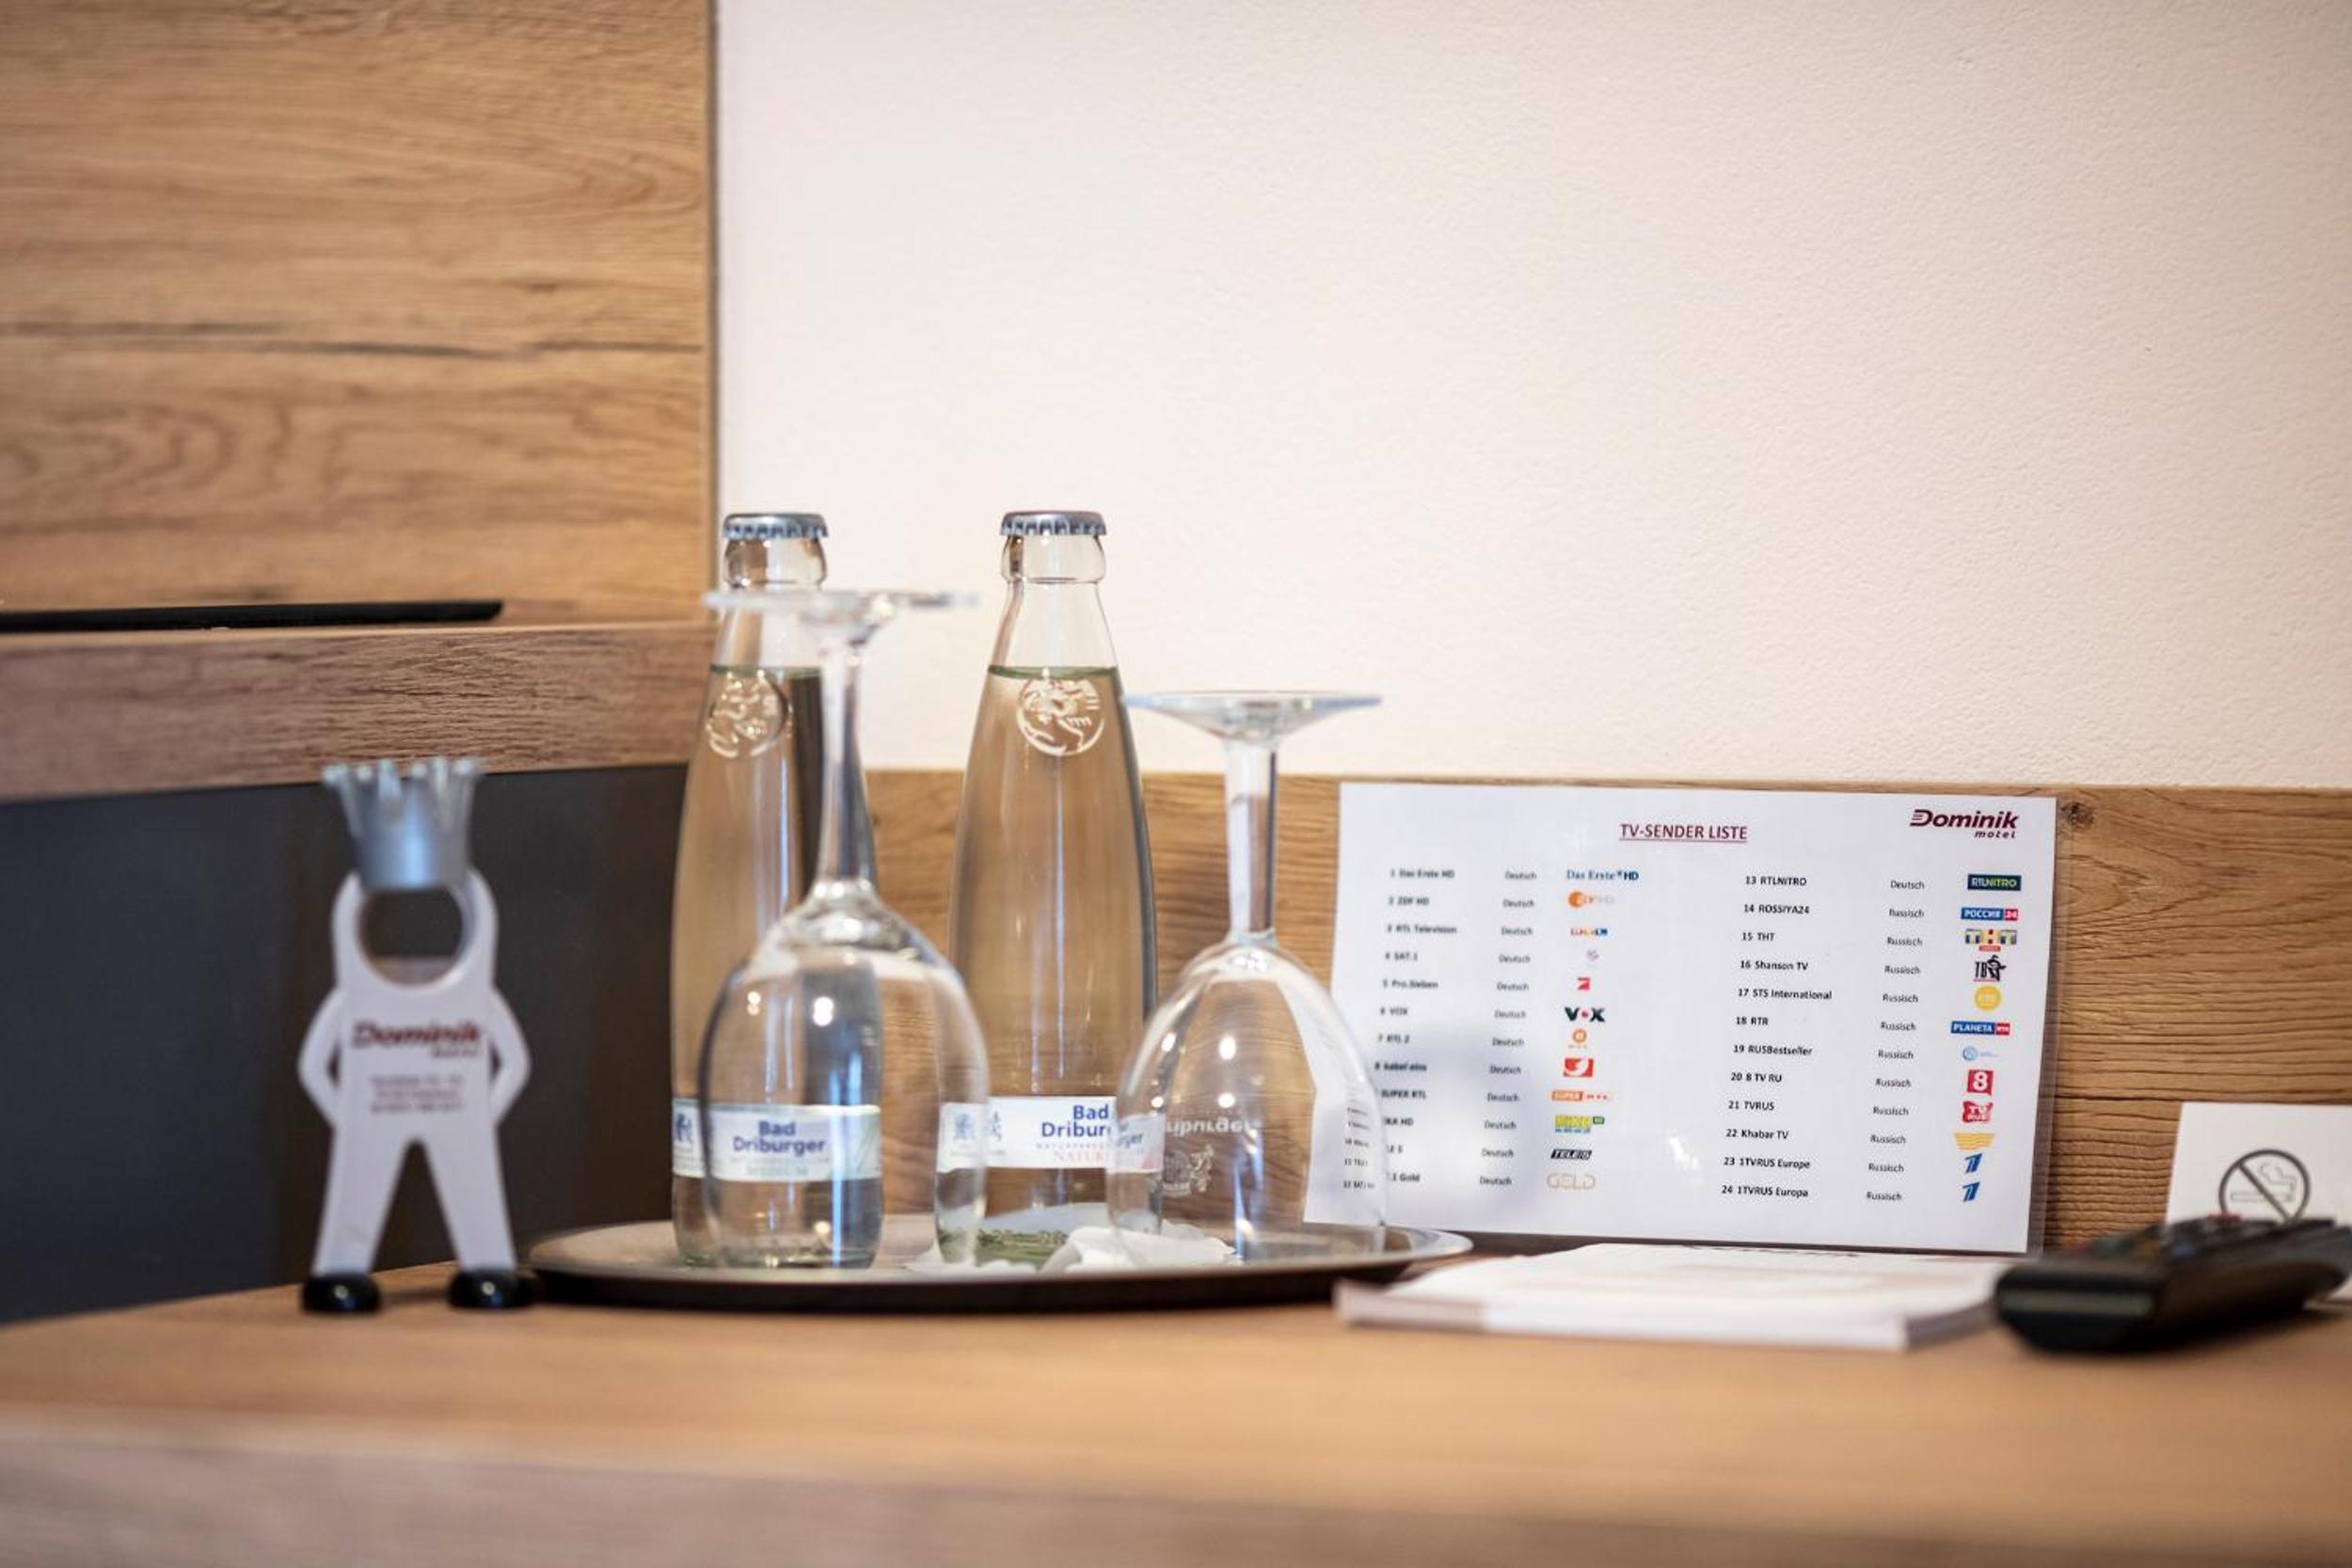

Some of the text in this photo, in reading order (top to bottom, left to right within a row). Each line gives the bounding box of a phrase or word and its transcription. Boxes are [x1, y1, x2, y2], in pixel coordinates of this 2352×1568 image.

[1910, 809, 2019, 829] Dominik
[1620, 824, 1748, 841] TV-SENDER LISTE
[1974, 830, 2016, 839] motel
[1504, 870, 1537, 880] Deutsch
[1587, 869, 1616, 880] Erste
[1624, 871, 1639, 880] HD
[1745, 876, 1807, 886] 13 RTLNITRO
[1889, 879, 1925, 890] Deutsch
[1971, 877, 2017, 888] RTLNITRO
[1502, 898, 1534, 908] Deutsch
[1744, 904, 1810, 914] 14 ROSSIYA24
[1888, 909, 1924, 918] Russisch
[1500, 926, 1534, 936] Deutsch
[1742, 932, 1775, 942] 15 THT
[1886, 937, 1922, 946] Russisch
[1498, 954, 1531, 963] Deutsch
[1740, 960, 1809, 971] 16 Shanson TV
[1883, 965, 1920, 974] Russisch
[1496, 981, 1529, 991] Deutsch
[1738, 988, 1833, 1000] 17 STS International
[1882, 993, 1918, 1003] Russisch
[1493, 1009, 1526, 1019] Deutsch
[1736, 1016, 1769, 1025] 18 RTR
[1879, 1022, 1916, 1031] Russisch
[1953, 1023, 1993, 1033] PLANETA
[1491, 1037, 1524, 1047] Deutsch
[1733, 1044, 1813, 1055] 19 RUSBestseller
[1877, 1050, 1914, 1059] Russisch
[1488, 1064, 1521, 1074] Deutsch
[1730, 1072, 1782, 1083] 20 8 TV RU
[1874, 1078, 1912, 1087] Russisch
[1973, 1072, 1988, 1091] 8
[1486, 1092, 1519, 1102] Deutsch
[1728, 1100, 1775, 1111] 21 TVRUS
[1073, 1104, 1109, 1119] Bad
[1872, 1106, 1909, 1116] Russisch
[758, 1120, 796, 1136] Bad
[1484, 1120, 1517, 1130] Deutsch
[1725, 1128, 1789, 1139] 22 Khabar TV
[1869, 1134, 1906, 1144] Russisch
[733, 1135, 825, 1157] Driburger
[1480, 1148, 1514, 1157] Deutsch
[1724, 1156, 1811, 1170] 23 1TVRUS Europe
[1867, 1163, 1904, 1173] Russisch
[1479, 1176, 1512, 1186] Deutsch
[1722, 1185, 1808, 1198] 24 1TVRUS Europa
[1865, 1192, 1902, 1201] Russisch
